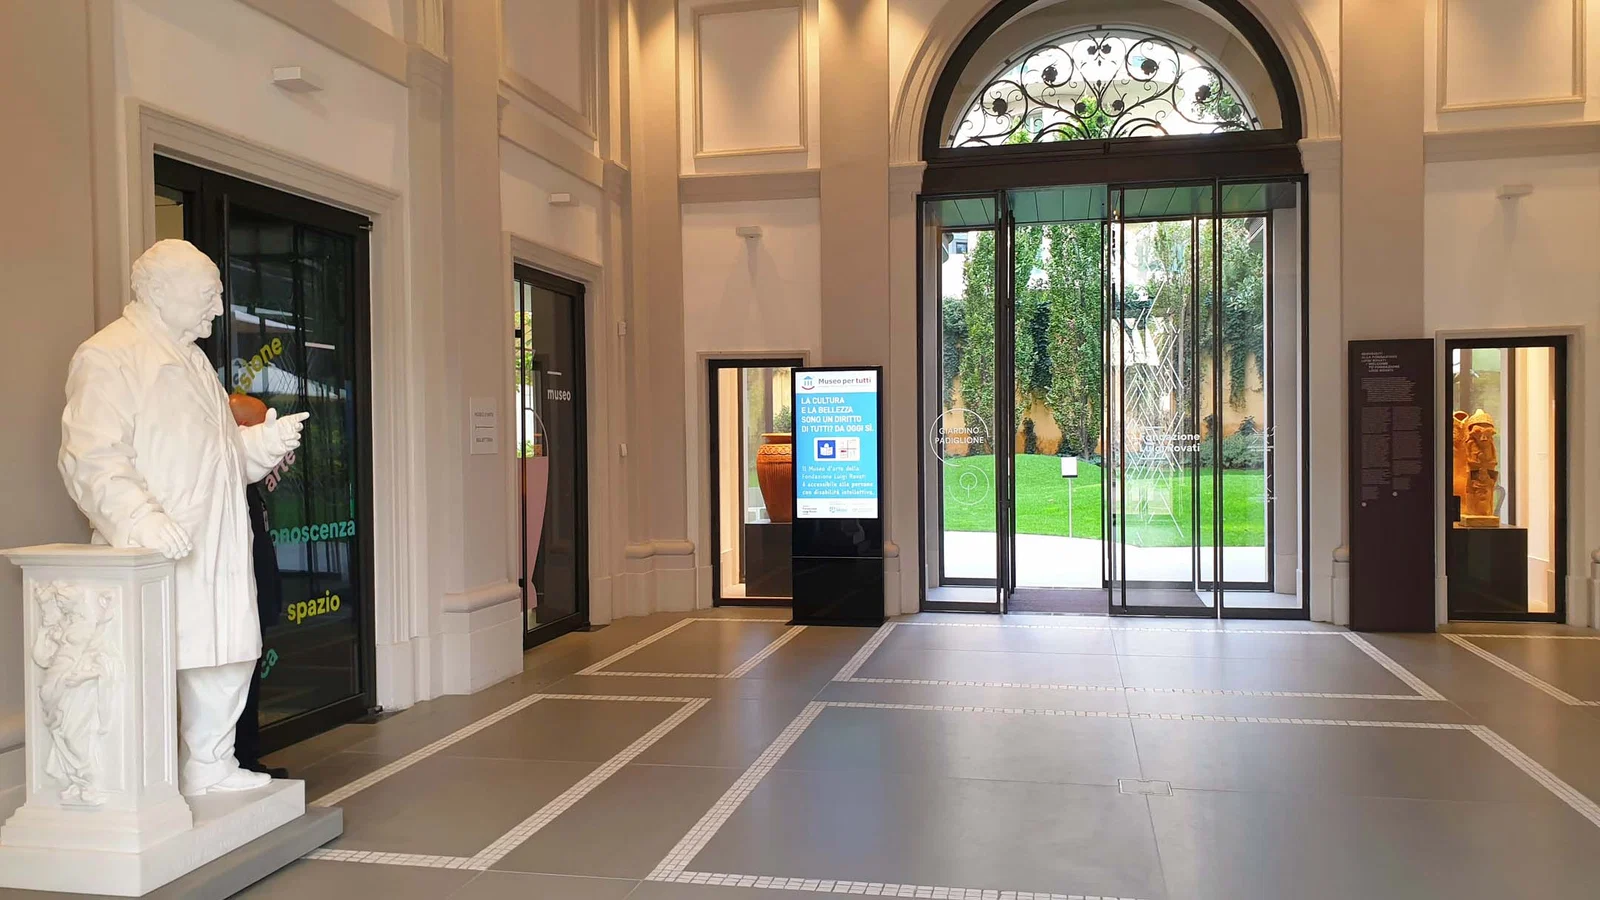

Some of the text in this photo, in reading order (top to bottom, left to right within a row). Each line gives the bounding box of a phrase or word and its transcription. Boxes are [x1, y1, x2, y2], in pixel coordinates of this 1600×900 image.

[233, 337, 282, 394] sione
[547, 390, 571, 401] museo
[270, 520, 355, 545] onoscenza
[288, 590, 340, 624] spazio
